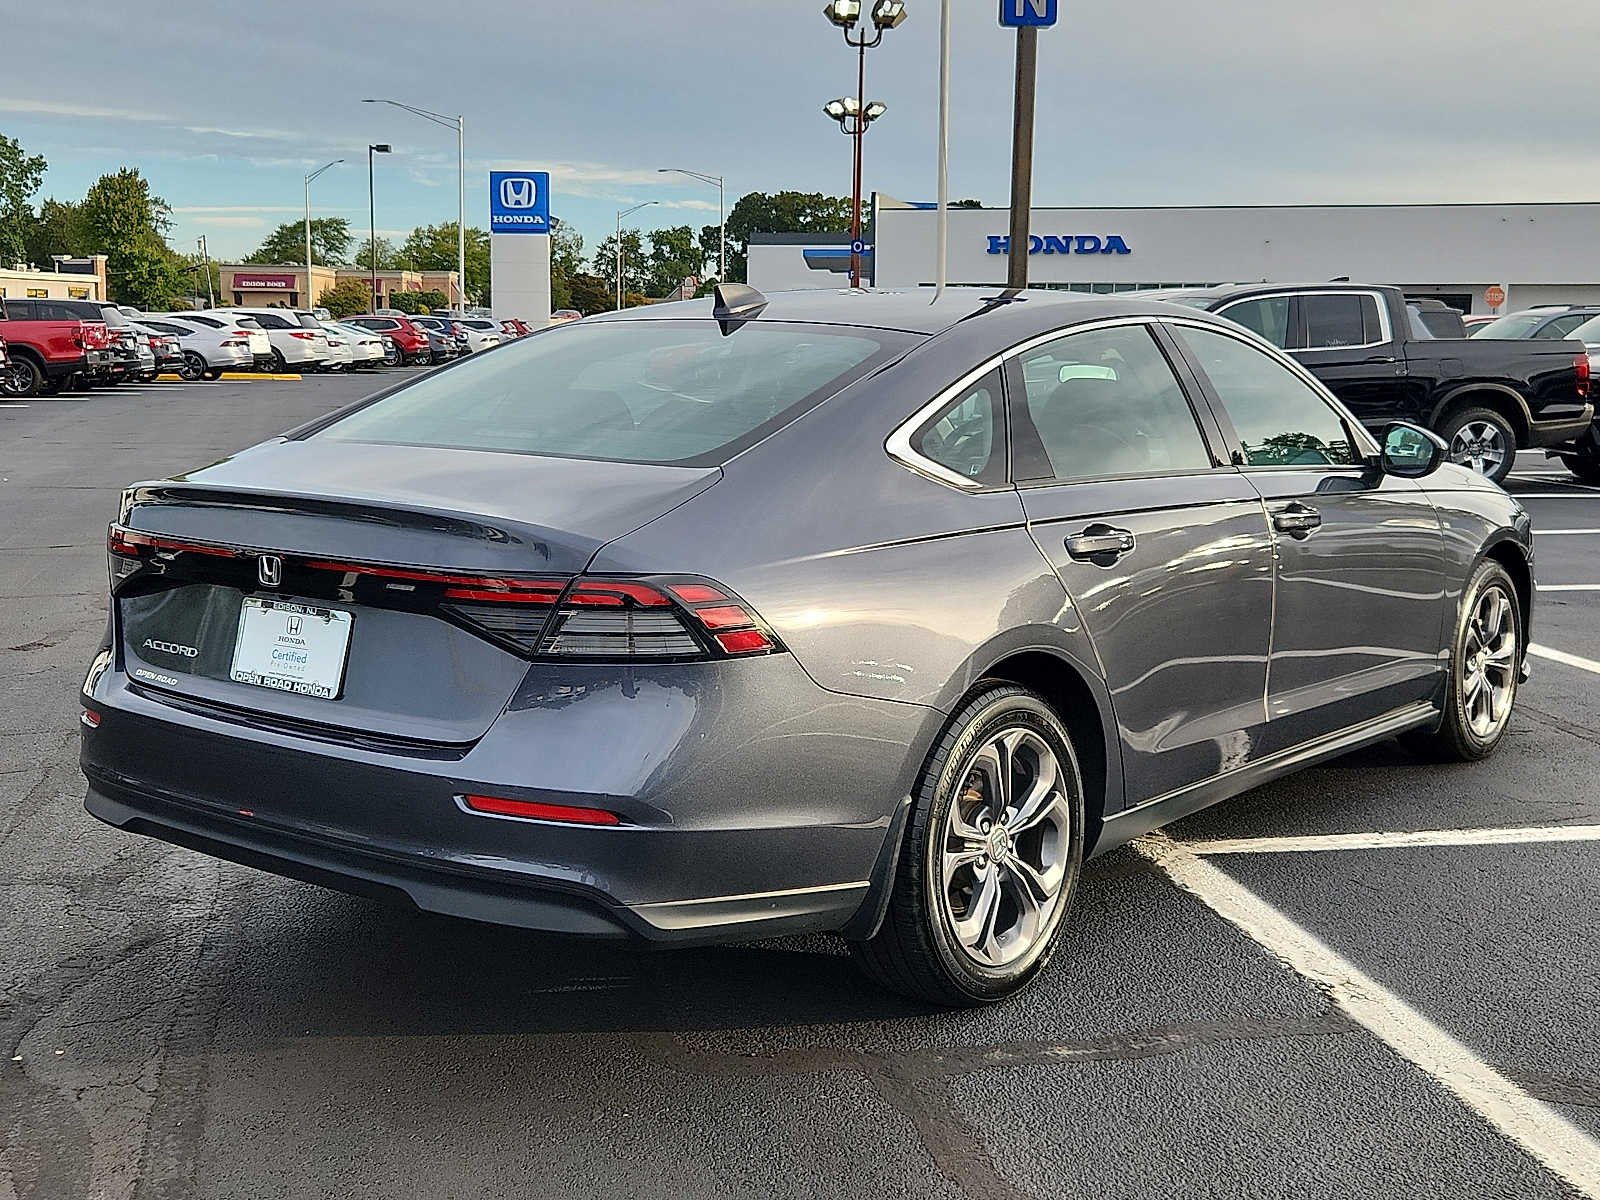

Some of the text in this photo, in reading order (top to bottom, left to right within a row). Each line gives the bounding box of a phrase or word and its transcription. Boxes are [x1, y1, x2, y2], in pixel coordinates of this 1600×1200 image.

[492, 215, 545, 224] HONDA
[1486, 292, 1504, 302] STOP
[306, 606, 318, 614] NJ
[277, 635, 306, 646] HONDA
[142, 638, 198, 657] ACCORD
[271, 649, 308, 664] Certified
[135, 668, 178, 686] OPEN ROAD
[235, 671, 262, 684] OPEN
[263, 677, 292, 690] ROAD
[293, 681, 329, 697] HONDA
